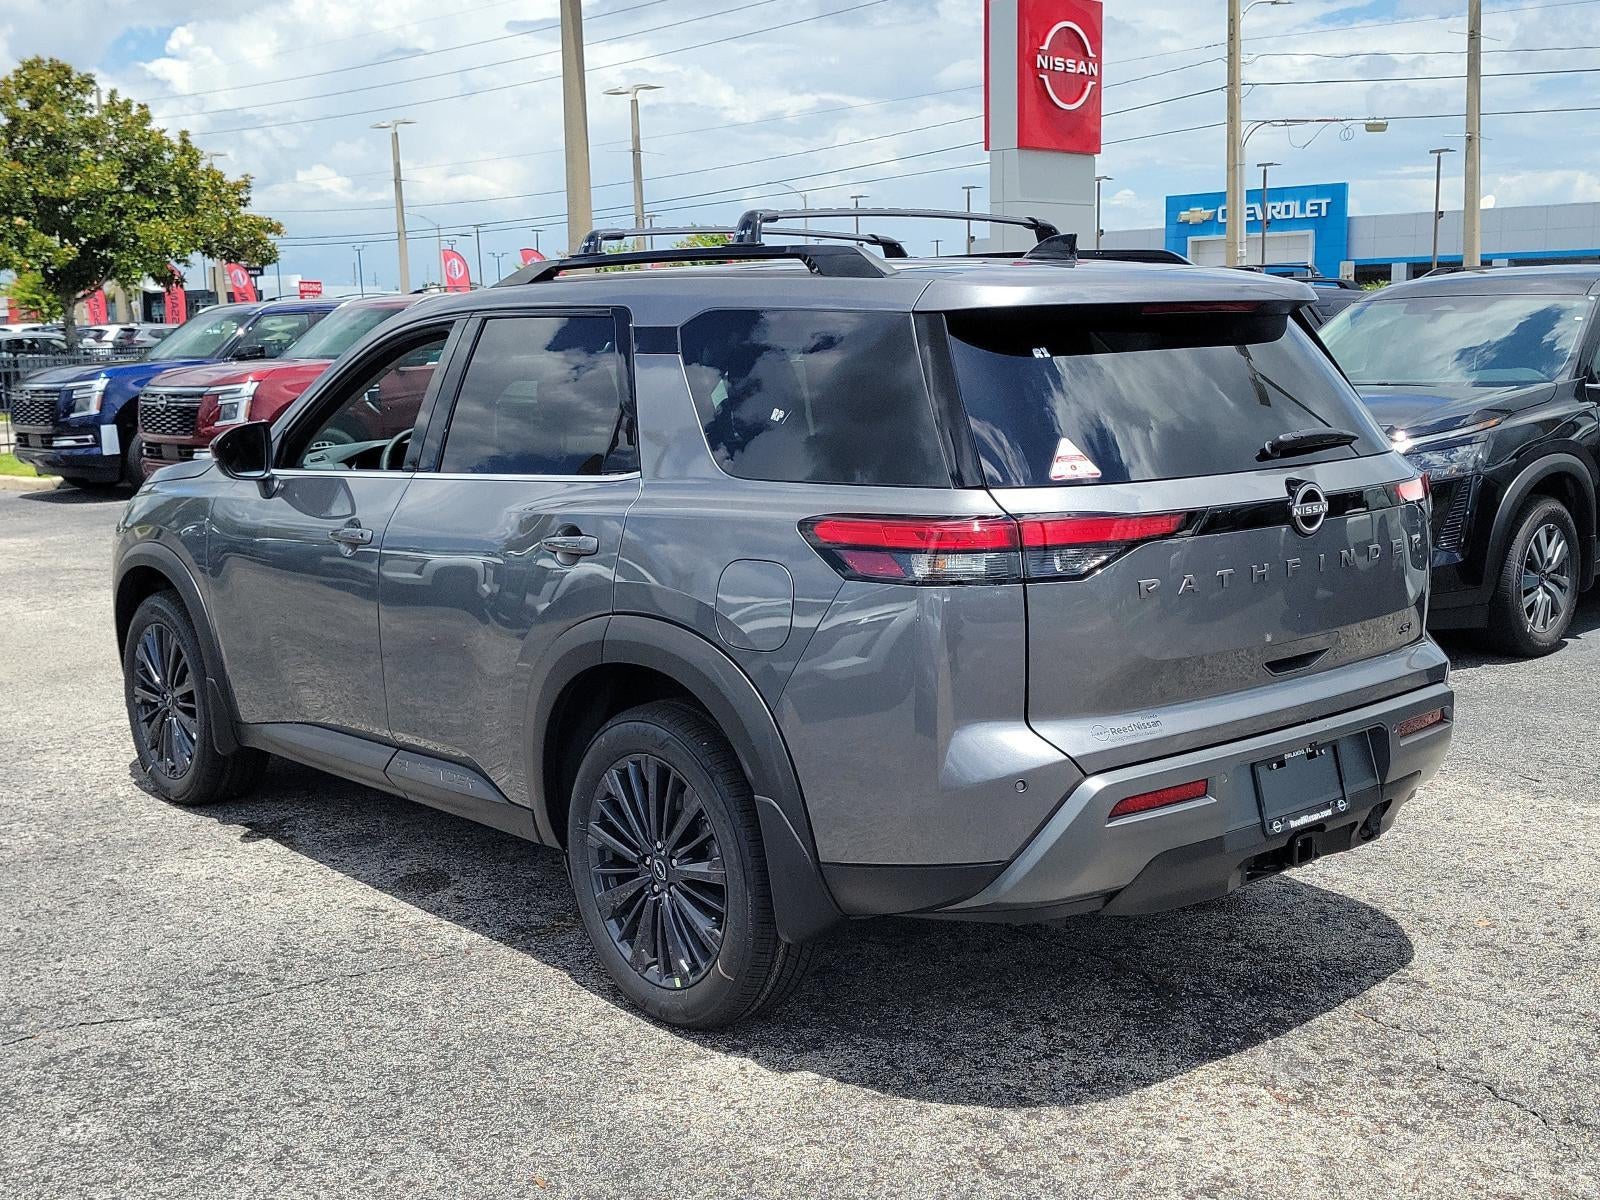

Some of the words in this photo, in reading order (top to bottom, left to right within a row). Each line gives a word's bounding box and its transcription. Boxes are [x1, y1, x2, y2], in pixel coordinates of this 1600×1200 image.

[1037, 54, 1098, 76] NISSAN
[1217, 198, 1331, 223] CEVROLET
[1293, 502, 1328, 516] NISSAN
[1138, 533, 1420, 599] PATHFINDER
[1109, 720, 1163, 736] ReedNissan
